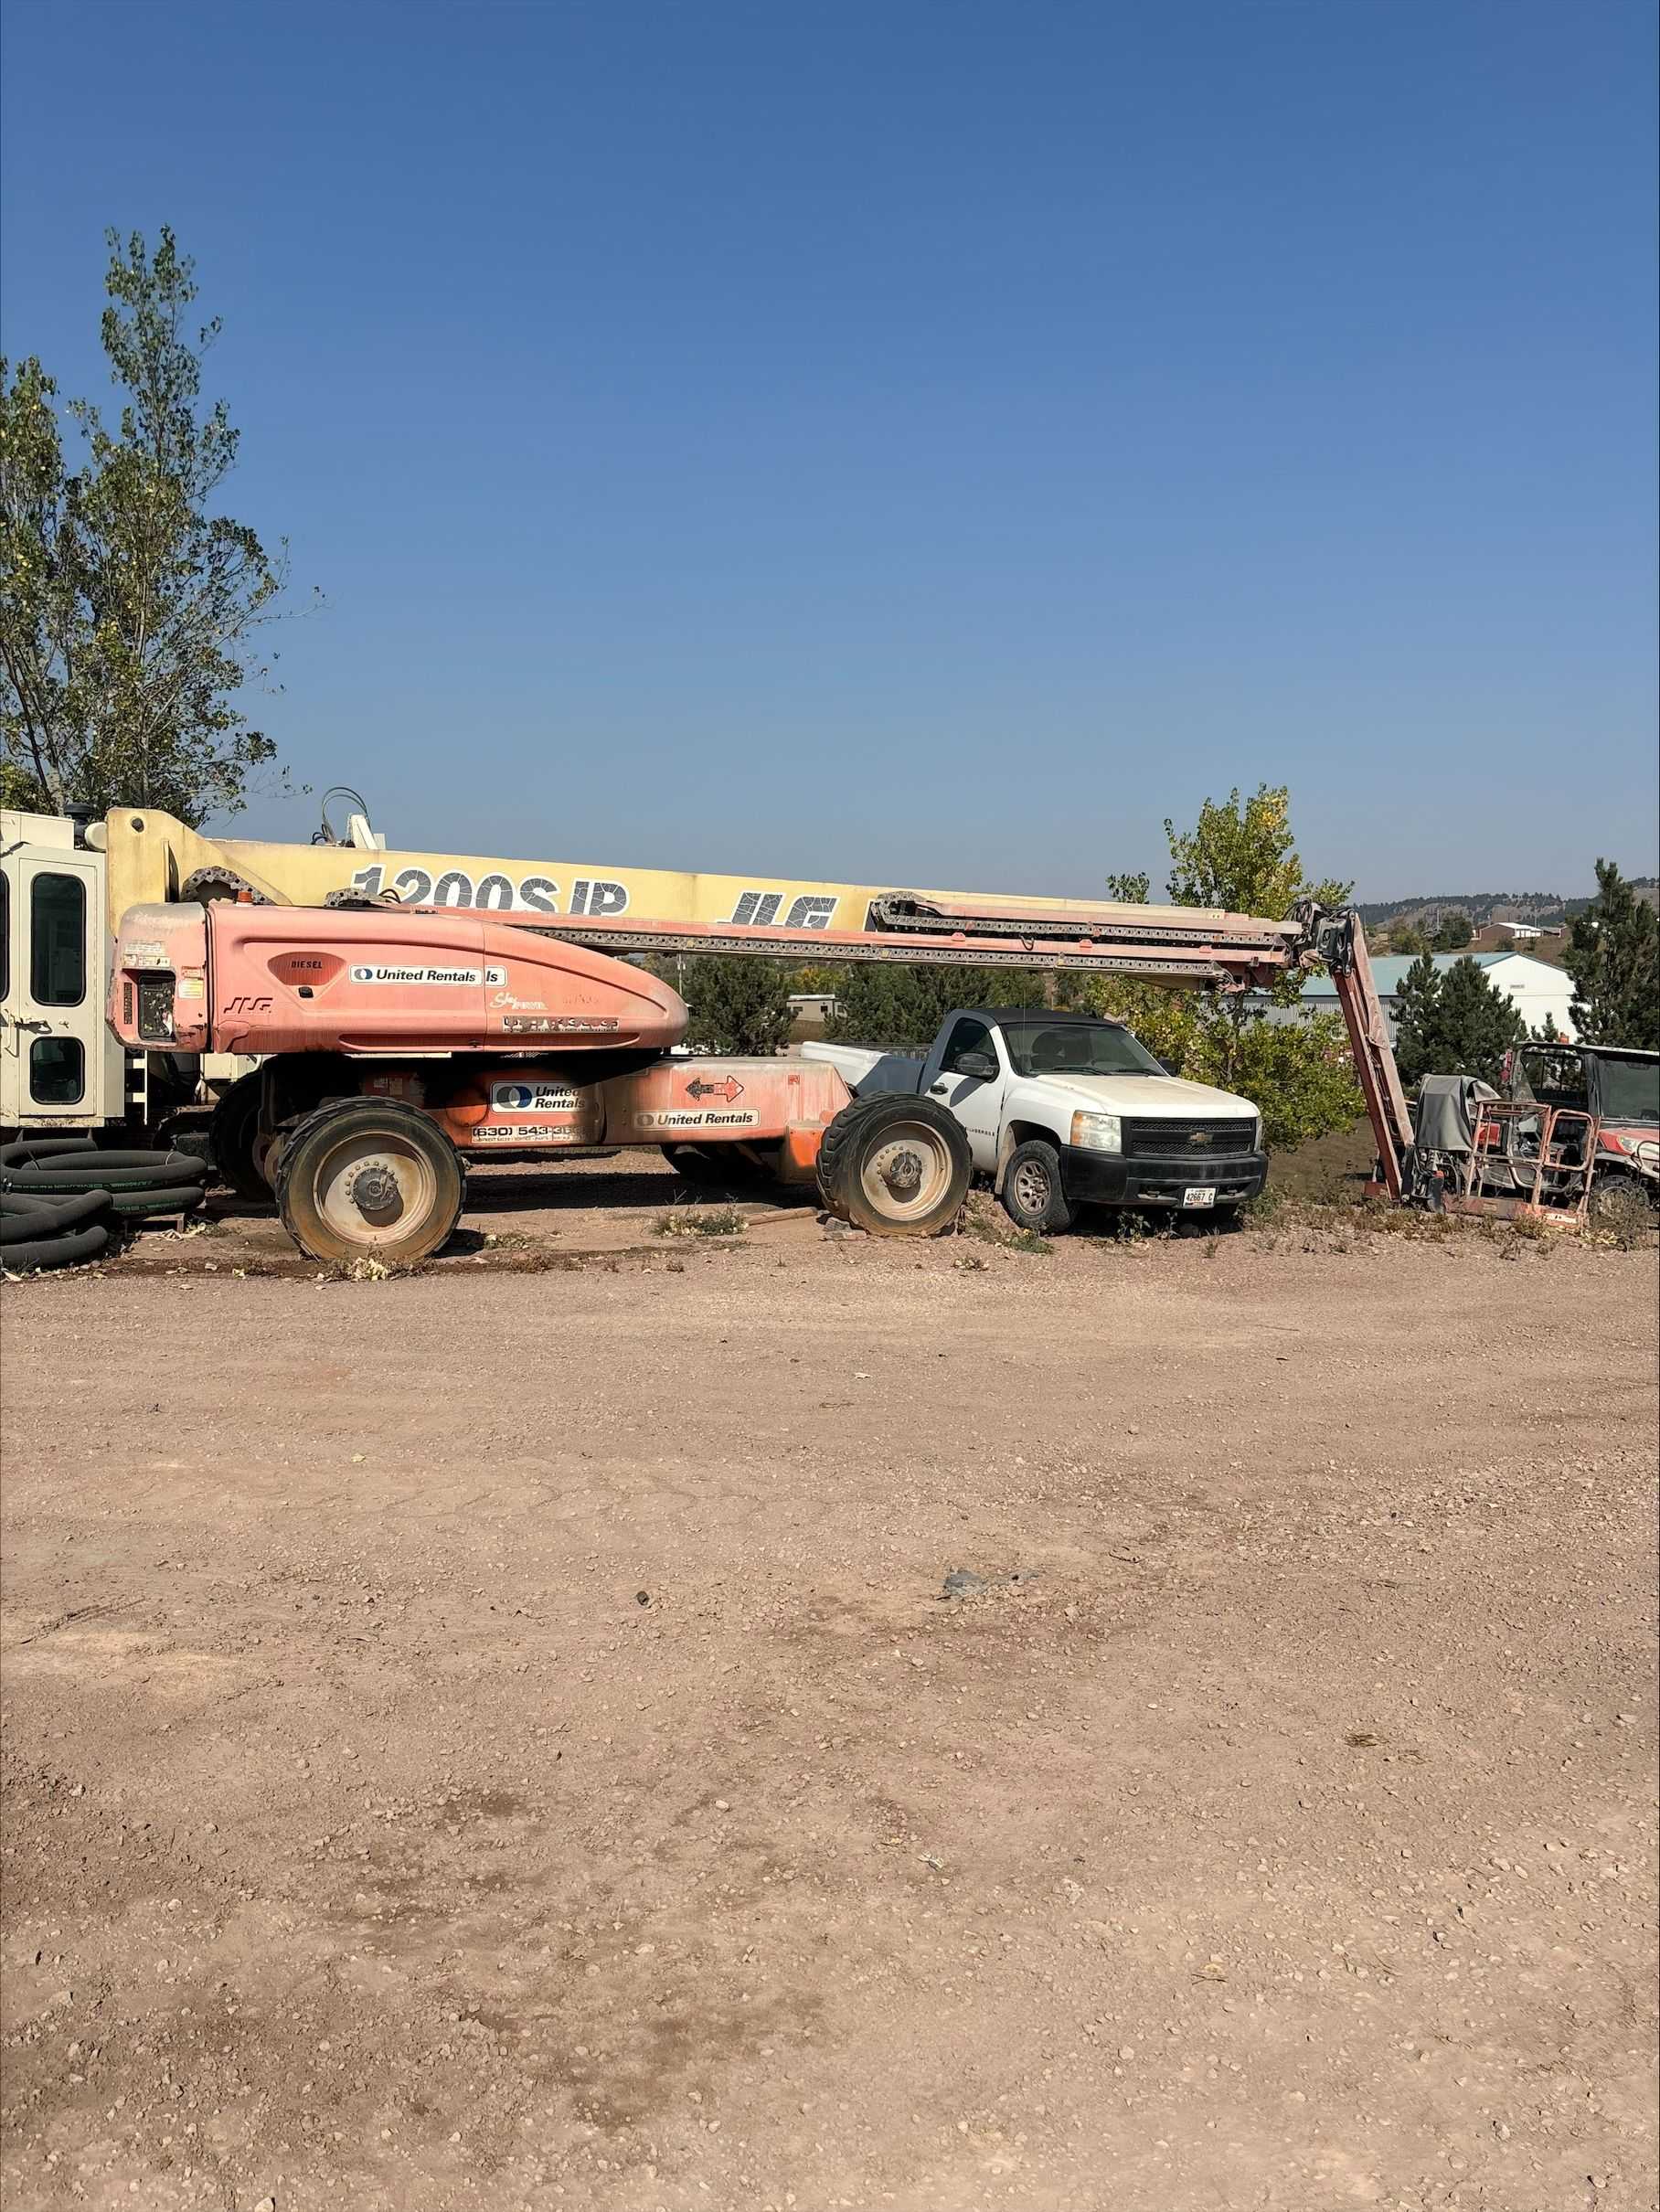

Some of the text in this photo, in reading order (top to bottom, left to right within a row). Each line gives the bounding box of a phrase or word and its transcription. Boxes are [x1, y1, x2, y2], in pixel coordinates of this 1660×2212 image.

[716, 892, 839, 929] JLG
[291, 960, 323, 969] DIESEL
[376, 969, 423, 981] United
[426, 970, 476, 983] Rentals
[534, 1097, 585, 1109] Rentals
[657, 1112, 754, 1126] United Rentals
[473, 1126, 513, 1136] (630)
[1208, 1192, 1213, 1201] C
